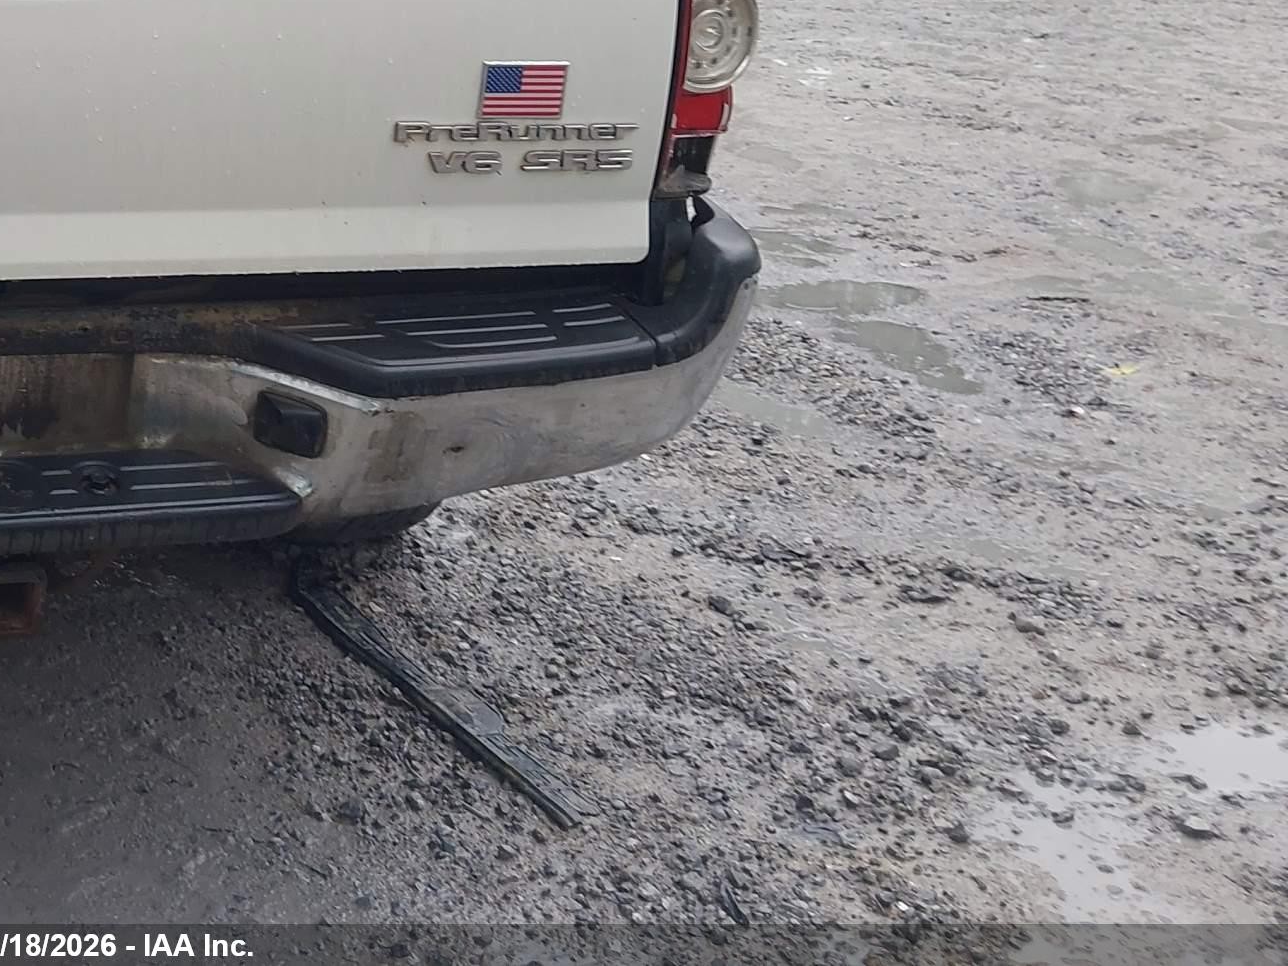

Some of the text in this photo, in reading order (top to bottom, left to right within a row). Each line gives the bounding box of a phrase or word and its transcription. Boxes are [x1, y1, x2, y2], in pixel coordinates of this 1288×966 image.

[393, 120, 640, 143] PreRunner
[428, 149, 633, 174] V6 SR5
